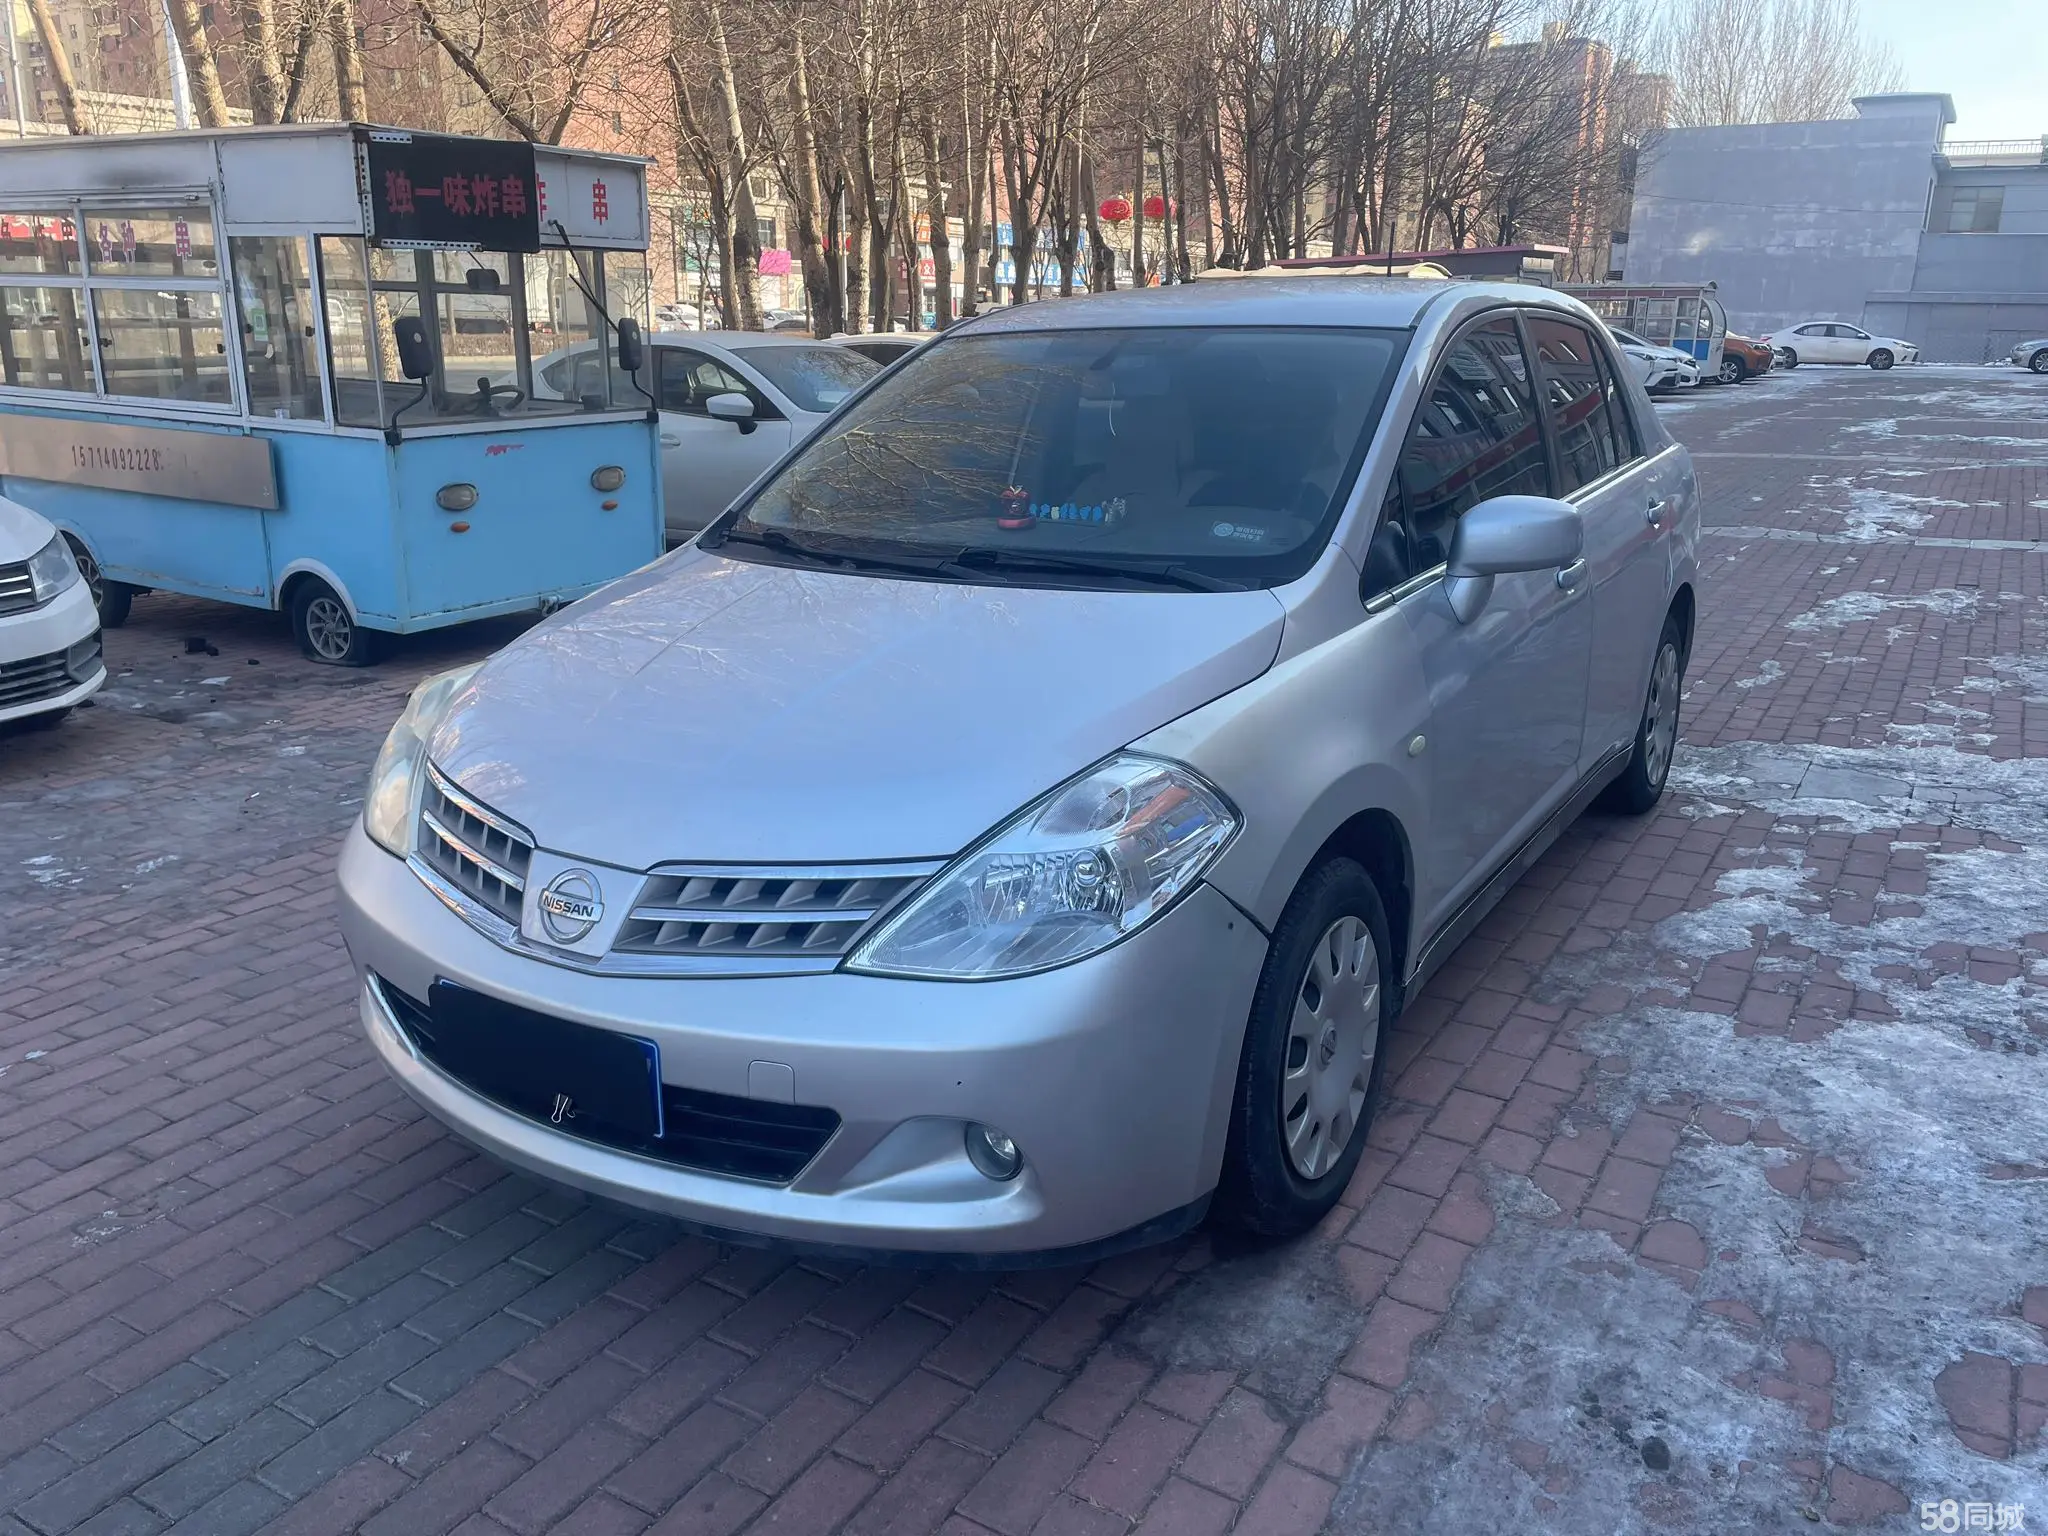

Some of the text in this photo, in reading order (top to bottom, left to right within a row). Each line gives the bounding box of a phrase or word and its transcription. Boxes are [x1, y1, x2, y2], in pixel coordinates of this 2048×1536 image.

[385, 169, 527, 219] 独一味炸串
[592, 178, 608, 225] 串
[72, 444, 160, 472] 15714092228
[543, 893, 594, 918] NISSAN
